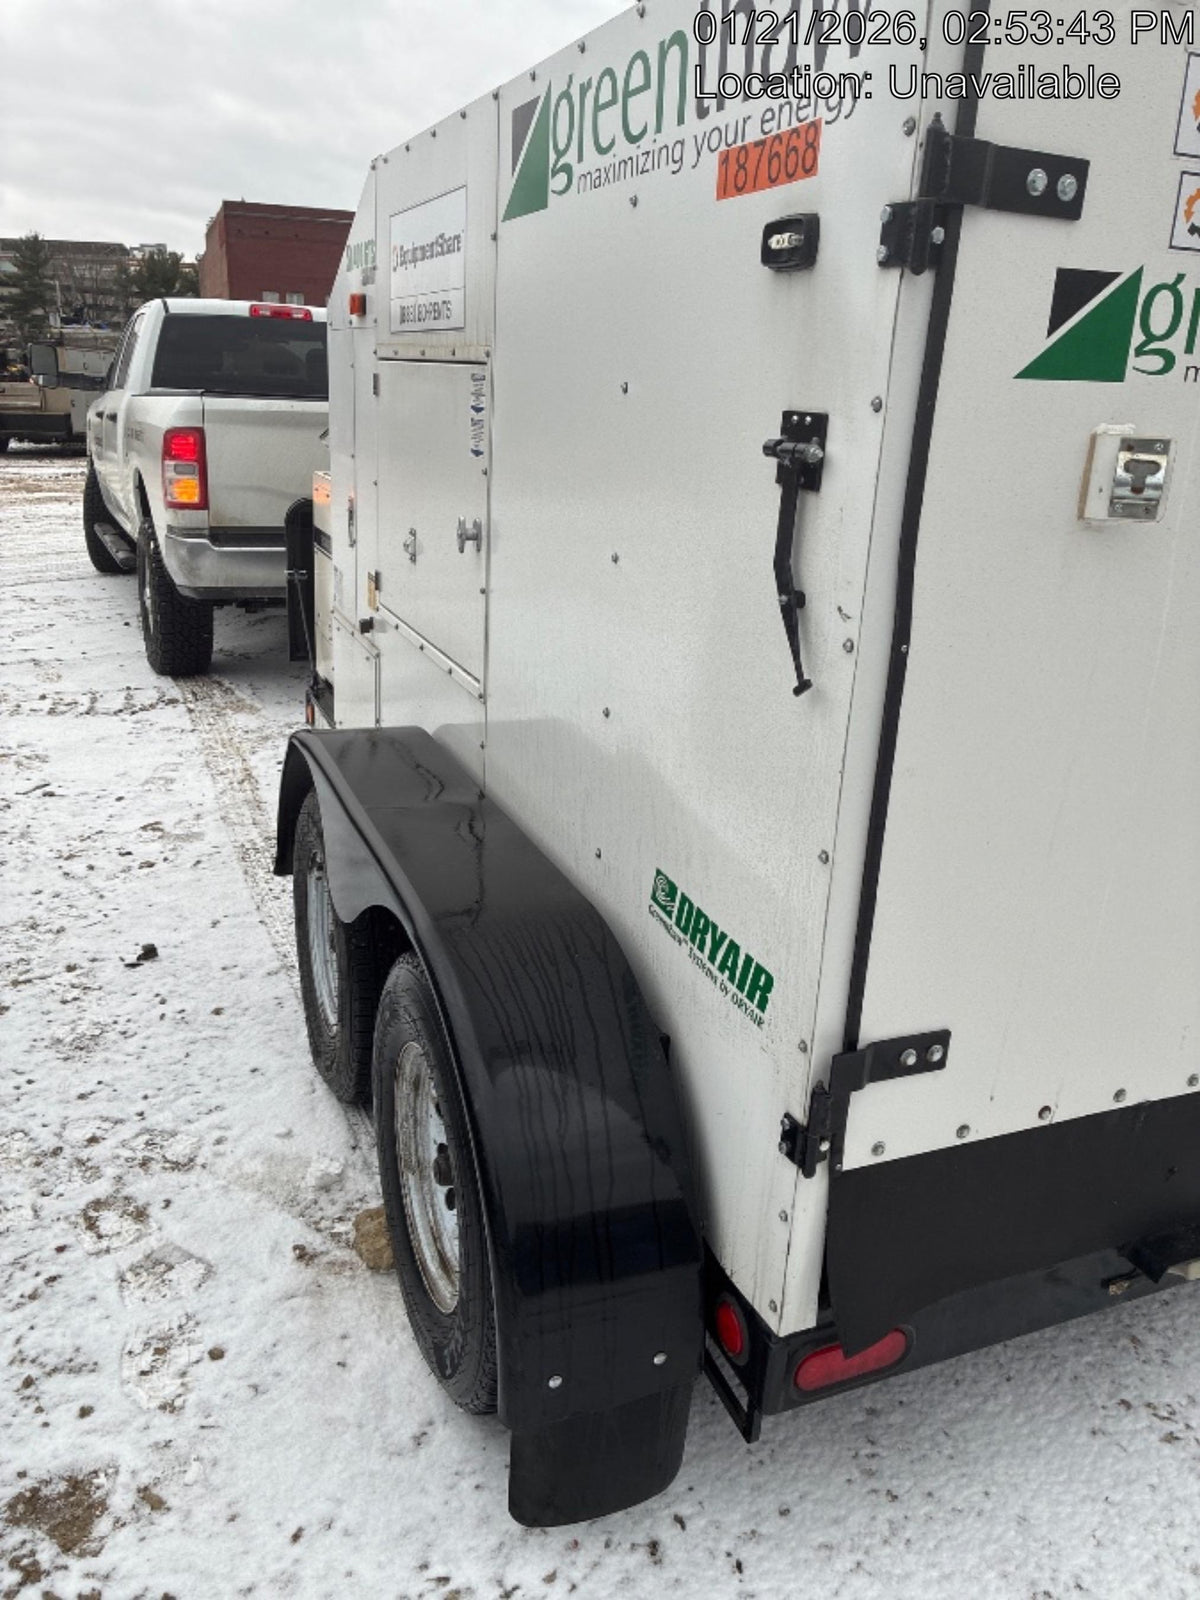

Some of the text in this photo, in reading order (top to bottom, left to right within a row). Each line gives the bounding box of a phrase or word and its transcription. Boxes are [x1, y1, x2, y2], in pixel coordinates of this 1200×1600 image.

[576, 70, 868, 195] maximizing your energy
[720, 122, 821, 197] 187668
[675, 891, 775, 1015] DRYAIR
